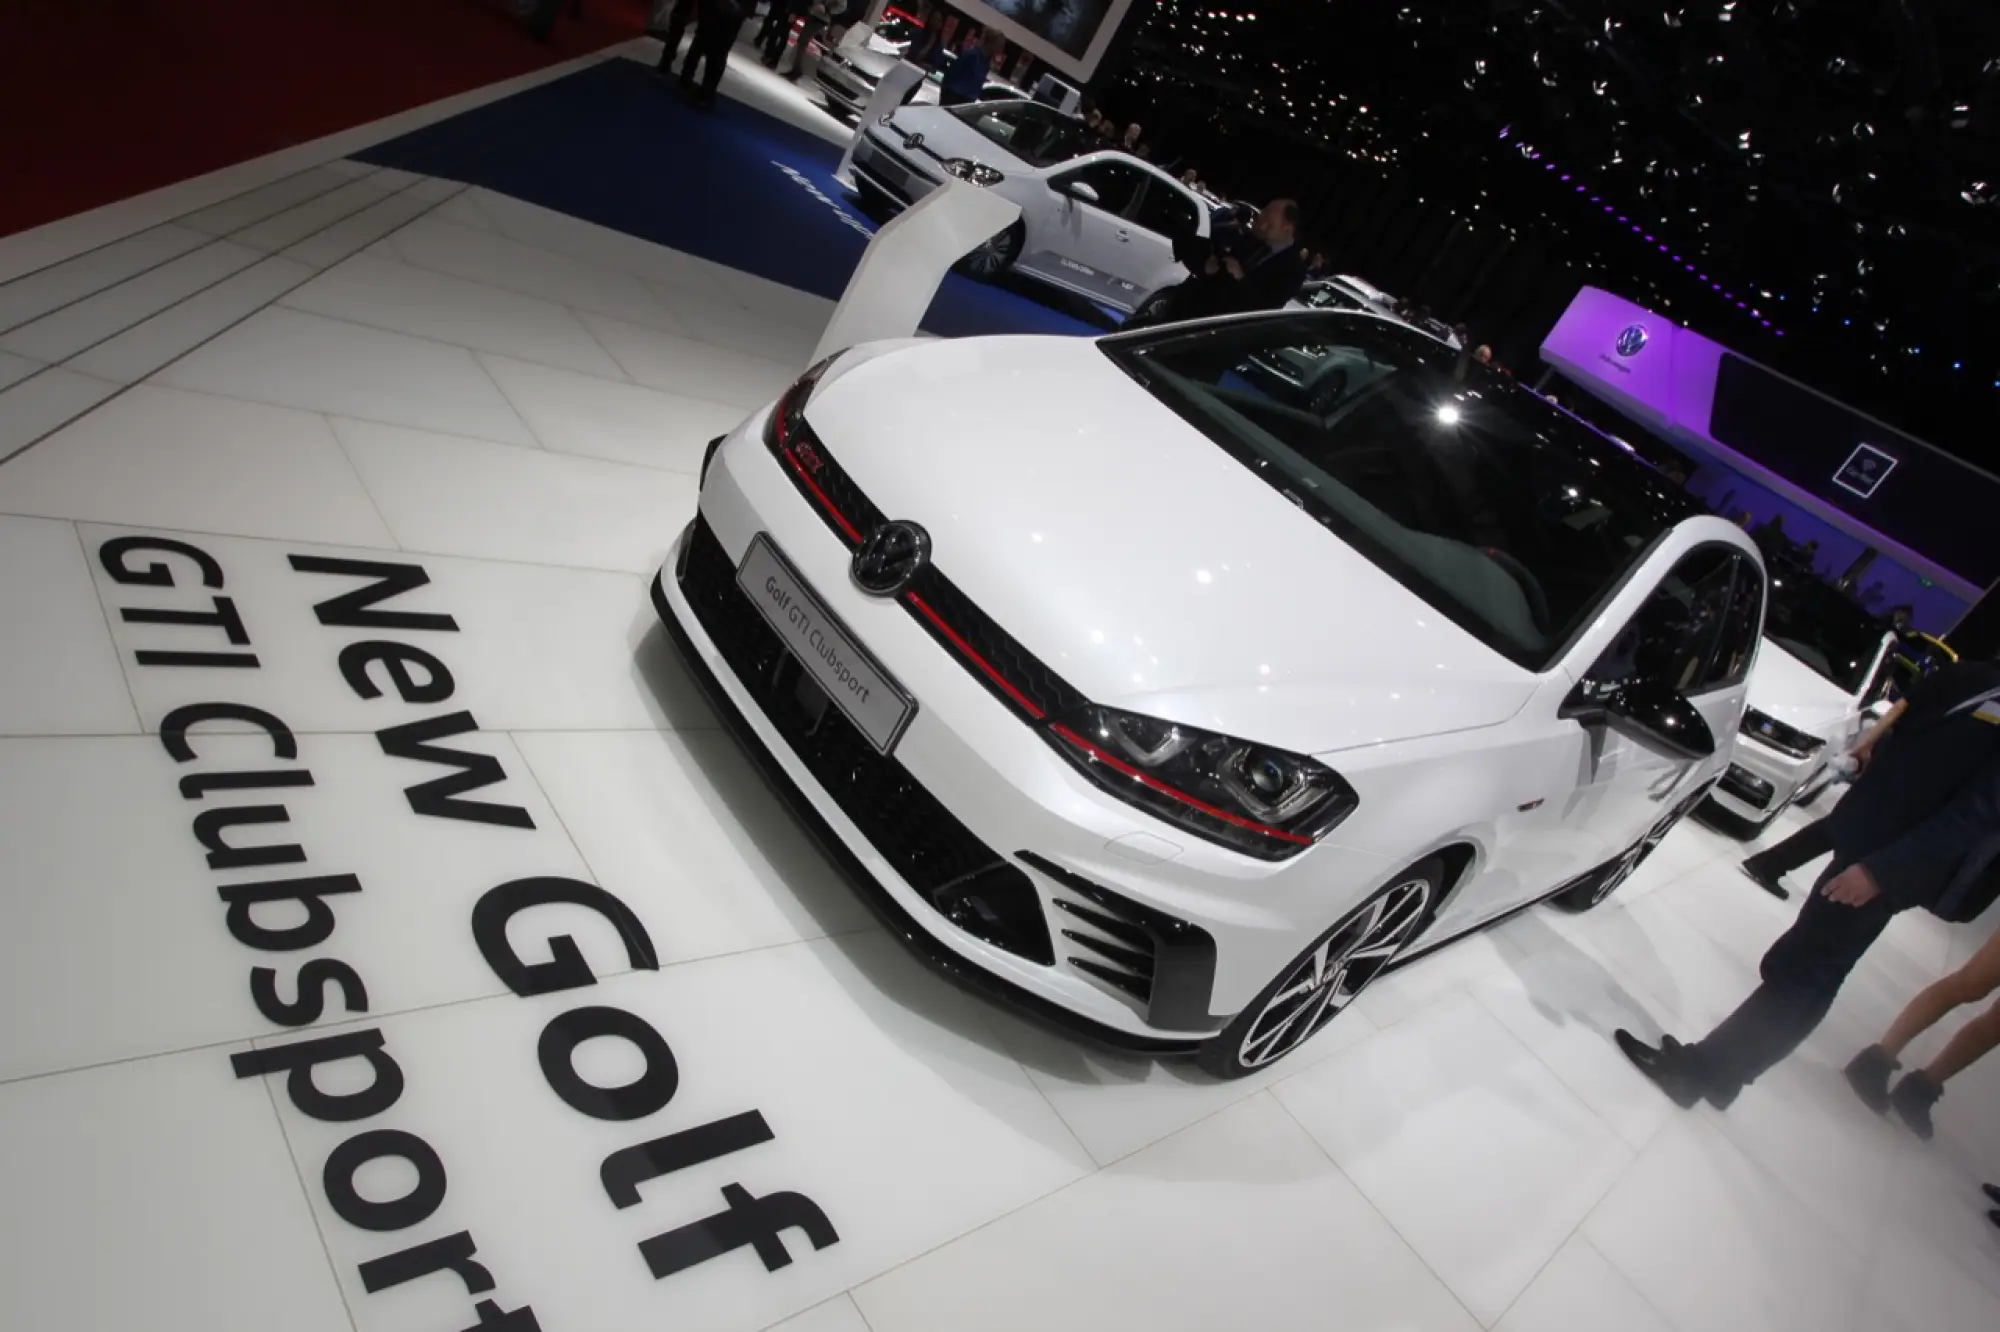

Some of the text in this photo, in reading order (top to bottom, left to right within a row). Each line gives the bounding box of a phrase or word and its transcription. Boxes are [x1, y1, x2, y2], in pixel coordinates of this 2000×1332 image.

[97, 535, 261, 669] GTI
[765, 575, 871, 703] Golf GTI Clubsport
[286, 553, 840, 1280] New Golf
